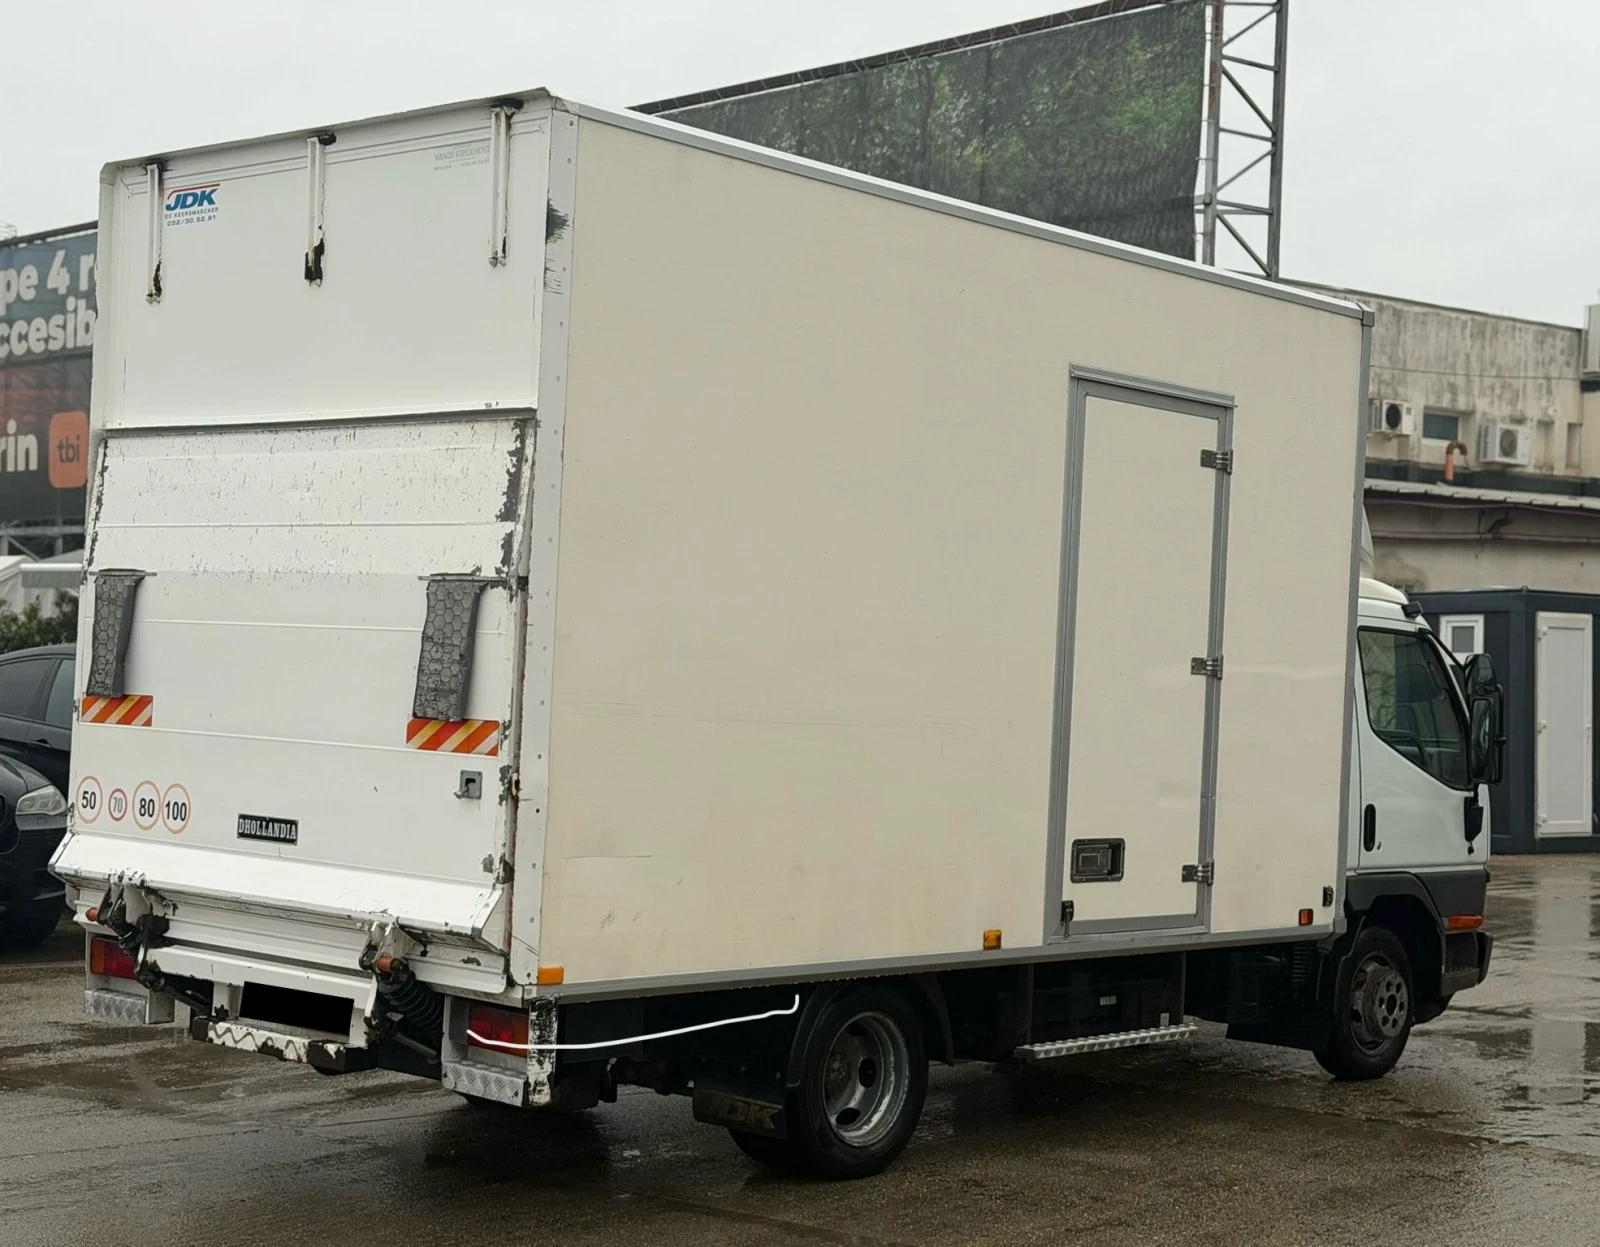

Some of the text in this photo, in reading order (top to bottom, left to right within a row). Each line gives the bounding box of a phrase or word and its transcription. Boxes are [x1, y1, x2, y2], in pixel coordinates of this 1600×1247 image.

[165, 188, 219, 212] JDK
[174, 207, 219, 218] KEERSMAECKER
[47, 250, 70, 294] 4
[79, 253, 98, 291] r
[57, 435, 80, 463] tbi
[81, 790, 97, 810] 50
[112, 796, 124, 813] 70
[139, 798, 155, 817] 80
[165, 800, 187, 821] 100
[238, 818, 297, 840] DHOLLANDIA
